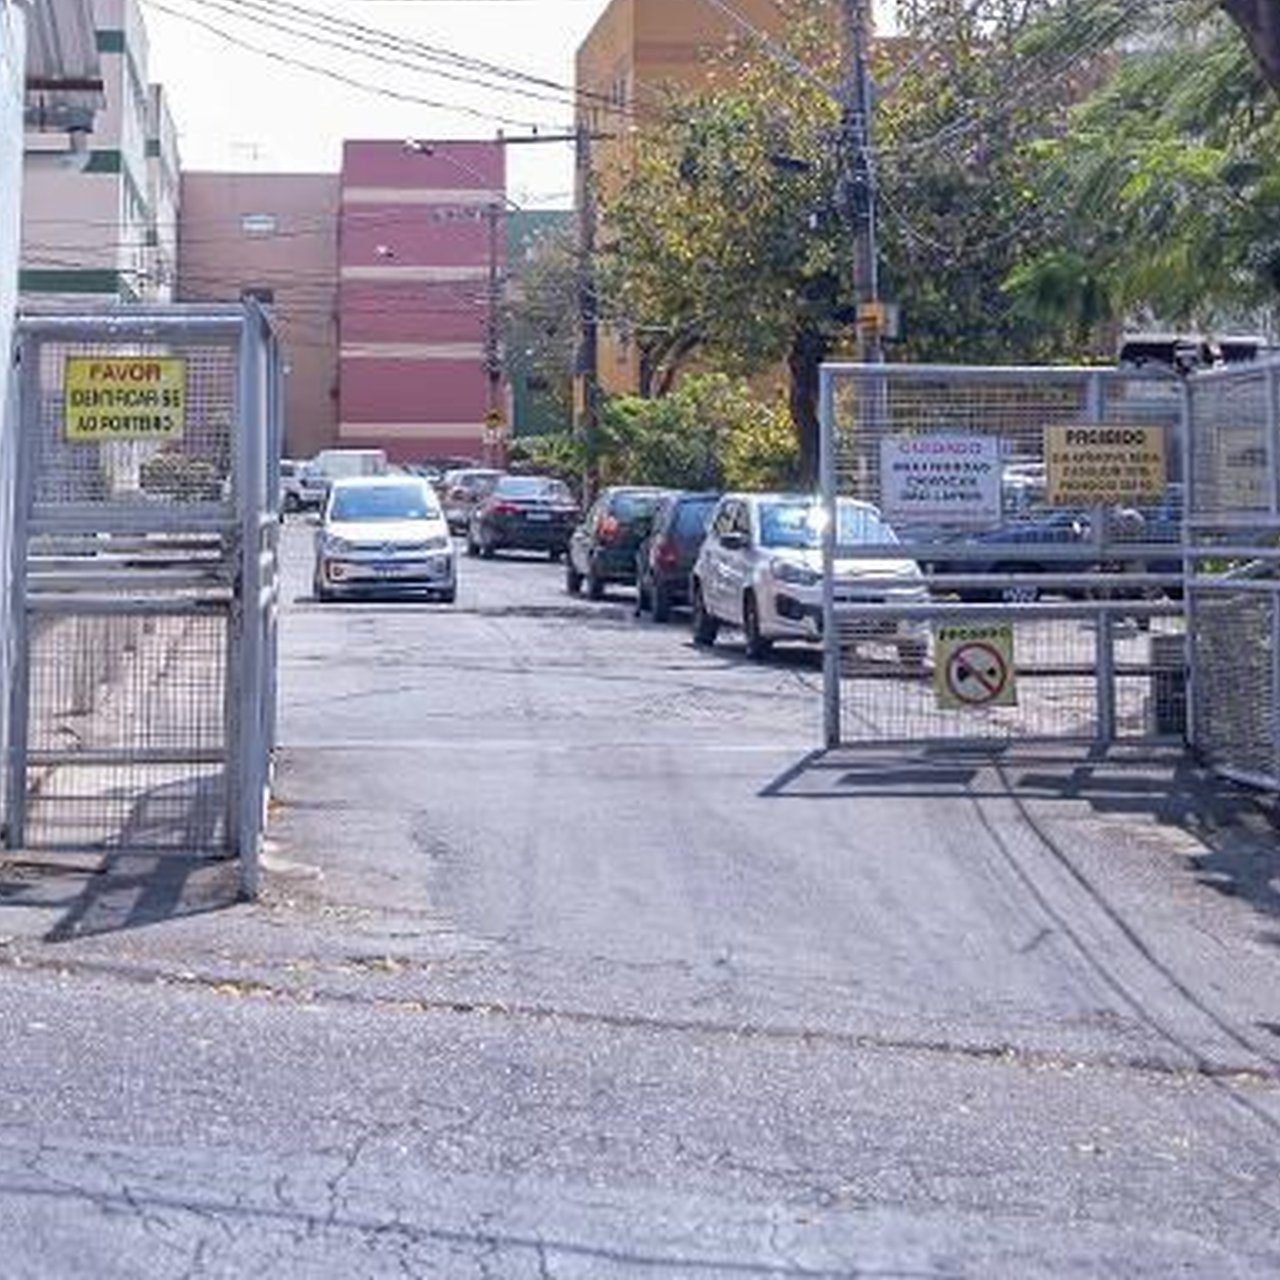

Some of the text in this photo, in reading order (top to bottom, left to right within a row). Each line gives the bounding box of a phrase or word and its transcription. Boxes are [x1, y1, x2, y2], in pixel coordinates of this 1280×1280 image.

[89, 363, 161, 381] FAVOR
[77, 415, 174, 432] AO PORTEIRO
[1065, 428, 1146, 445] PROIBIDO
[899, 441, 982, 455] CUIDADO
